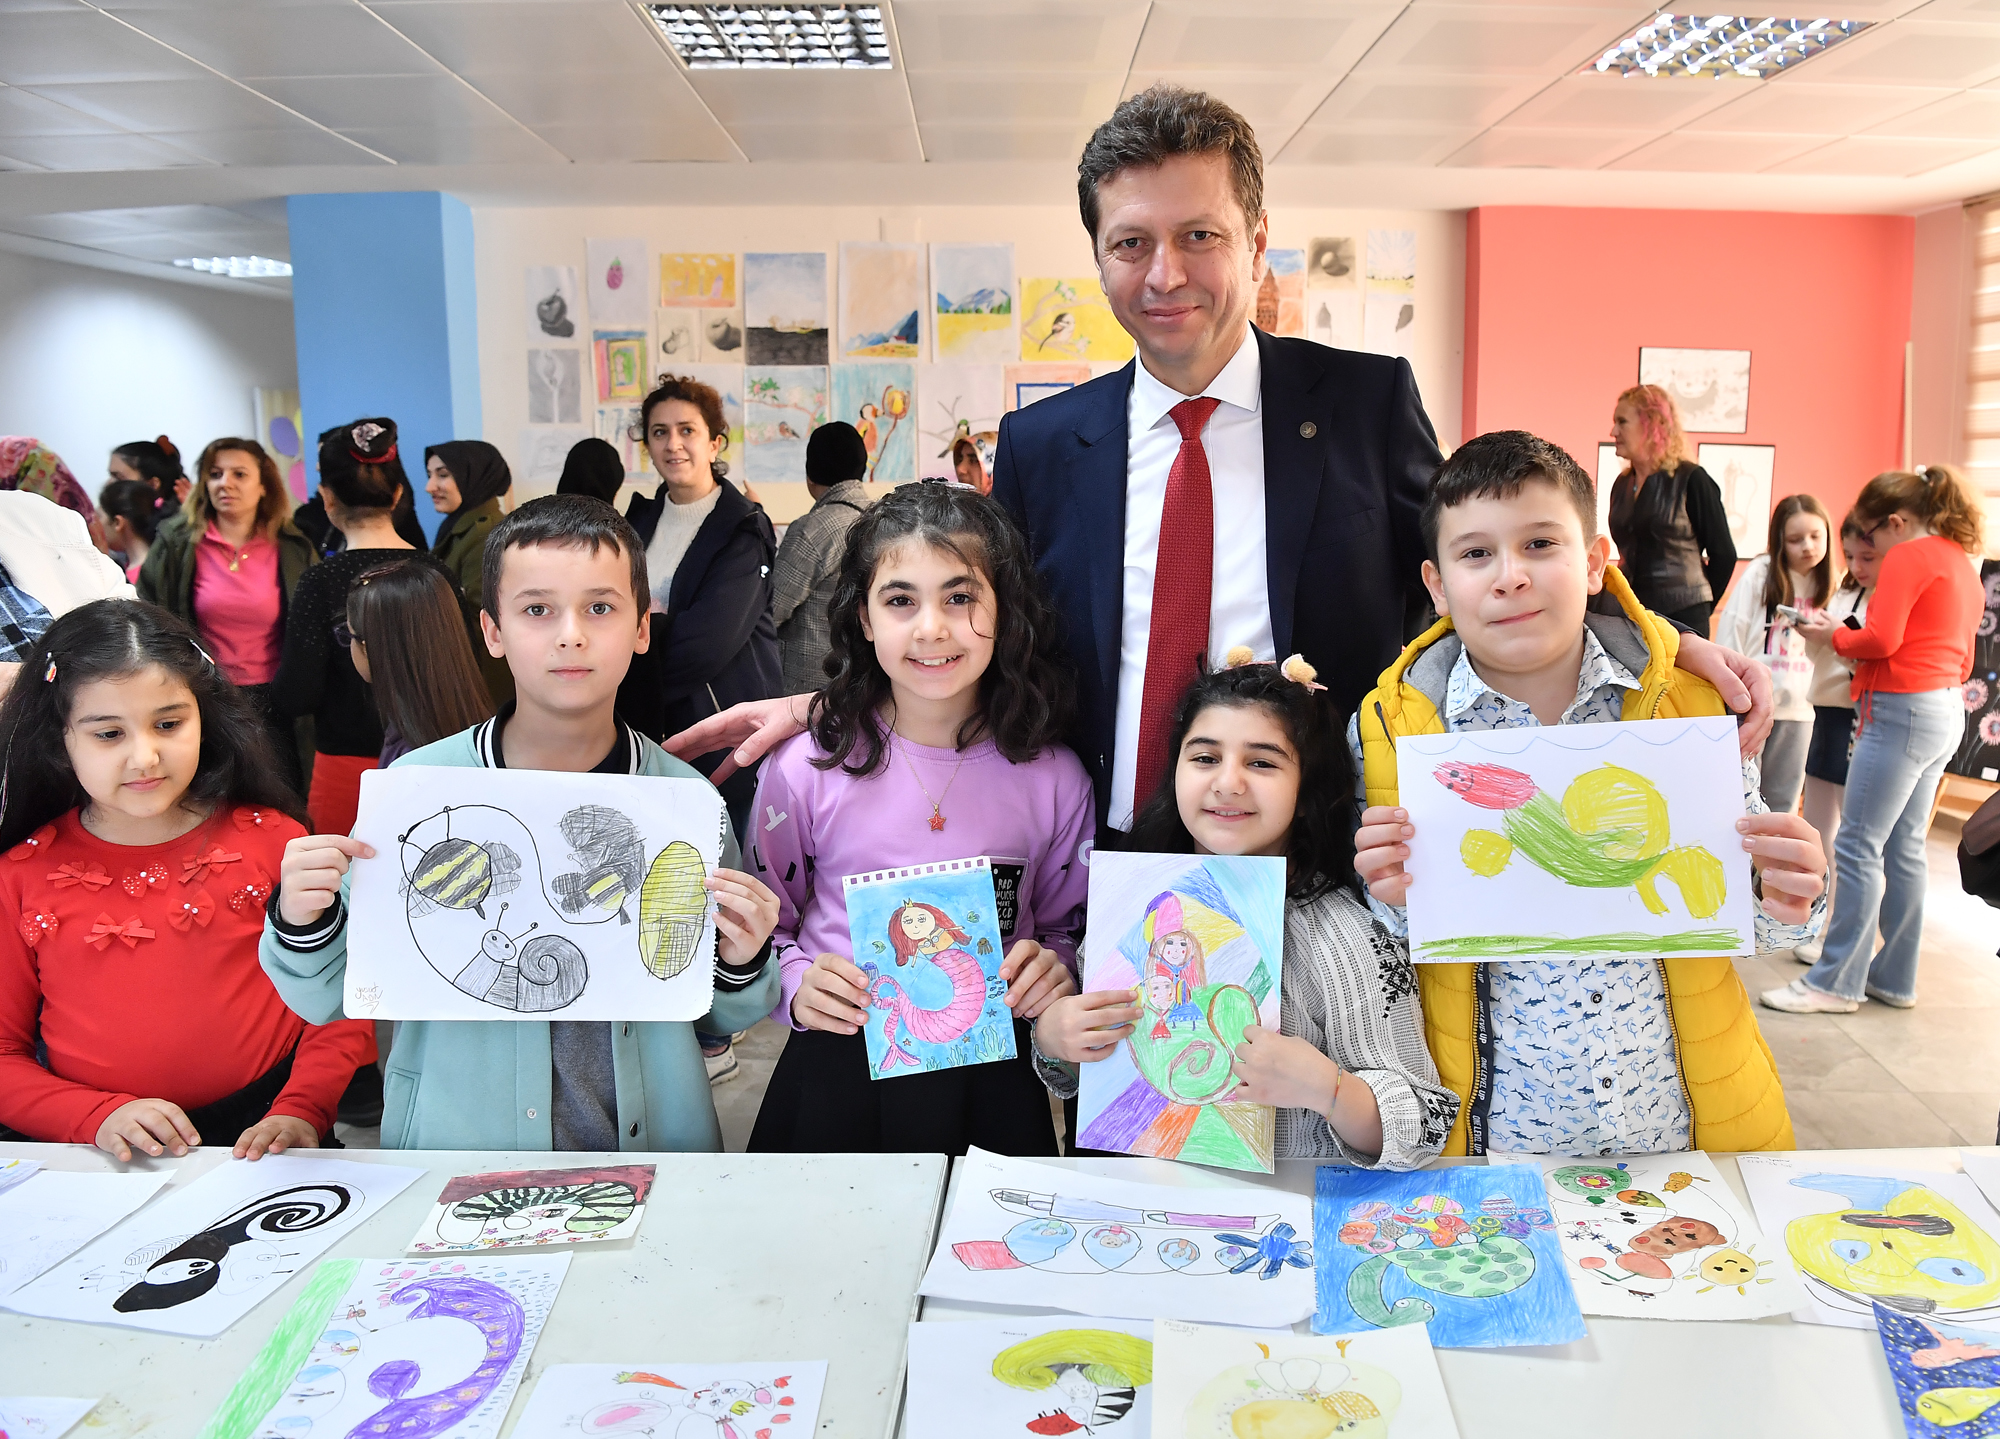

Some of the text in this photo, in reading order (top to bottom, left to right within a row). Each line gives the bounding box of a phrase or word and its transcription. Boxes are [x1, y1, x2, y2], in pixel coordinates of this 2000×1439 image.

[1478, 1032, 1488, 1044] UP
[1479, 1069, 1488, 1089] LEVEL
[1477, 1089, 1486, 1101] UP
[1473, 1126, 1483, 1142] LEVEL
[1474, 1143, 1483, 1154] UP
